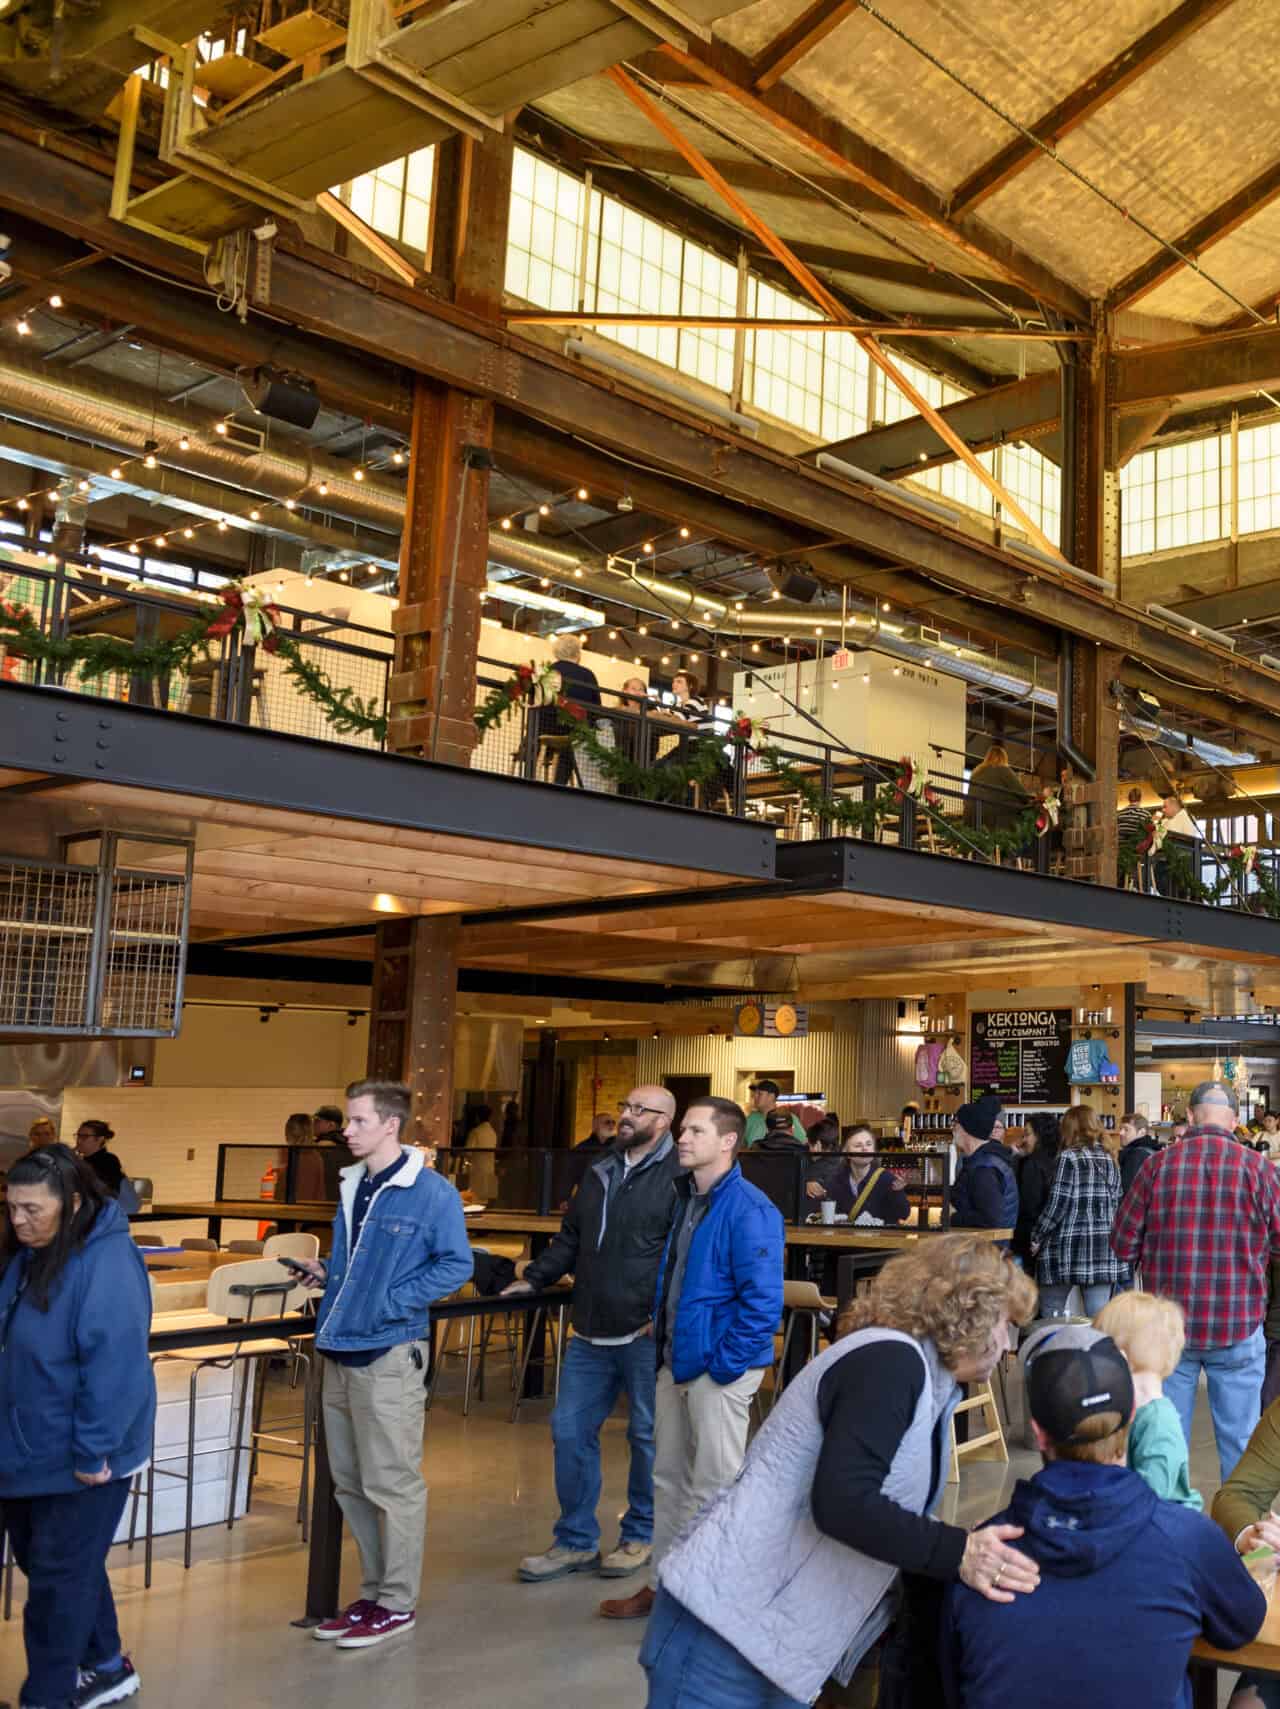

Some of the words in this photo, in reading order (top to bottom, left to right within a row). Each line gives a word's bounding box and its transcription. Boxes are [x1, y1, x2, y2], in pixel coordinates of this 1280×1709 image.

[987, 1011, 1057, 1027] KEKIONGA
[986, 1028, 1011, 1038] CRAFT
[1011, 1027, 1048, 1037] COMPANY
